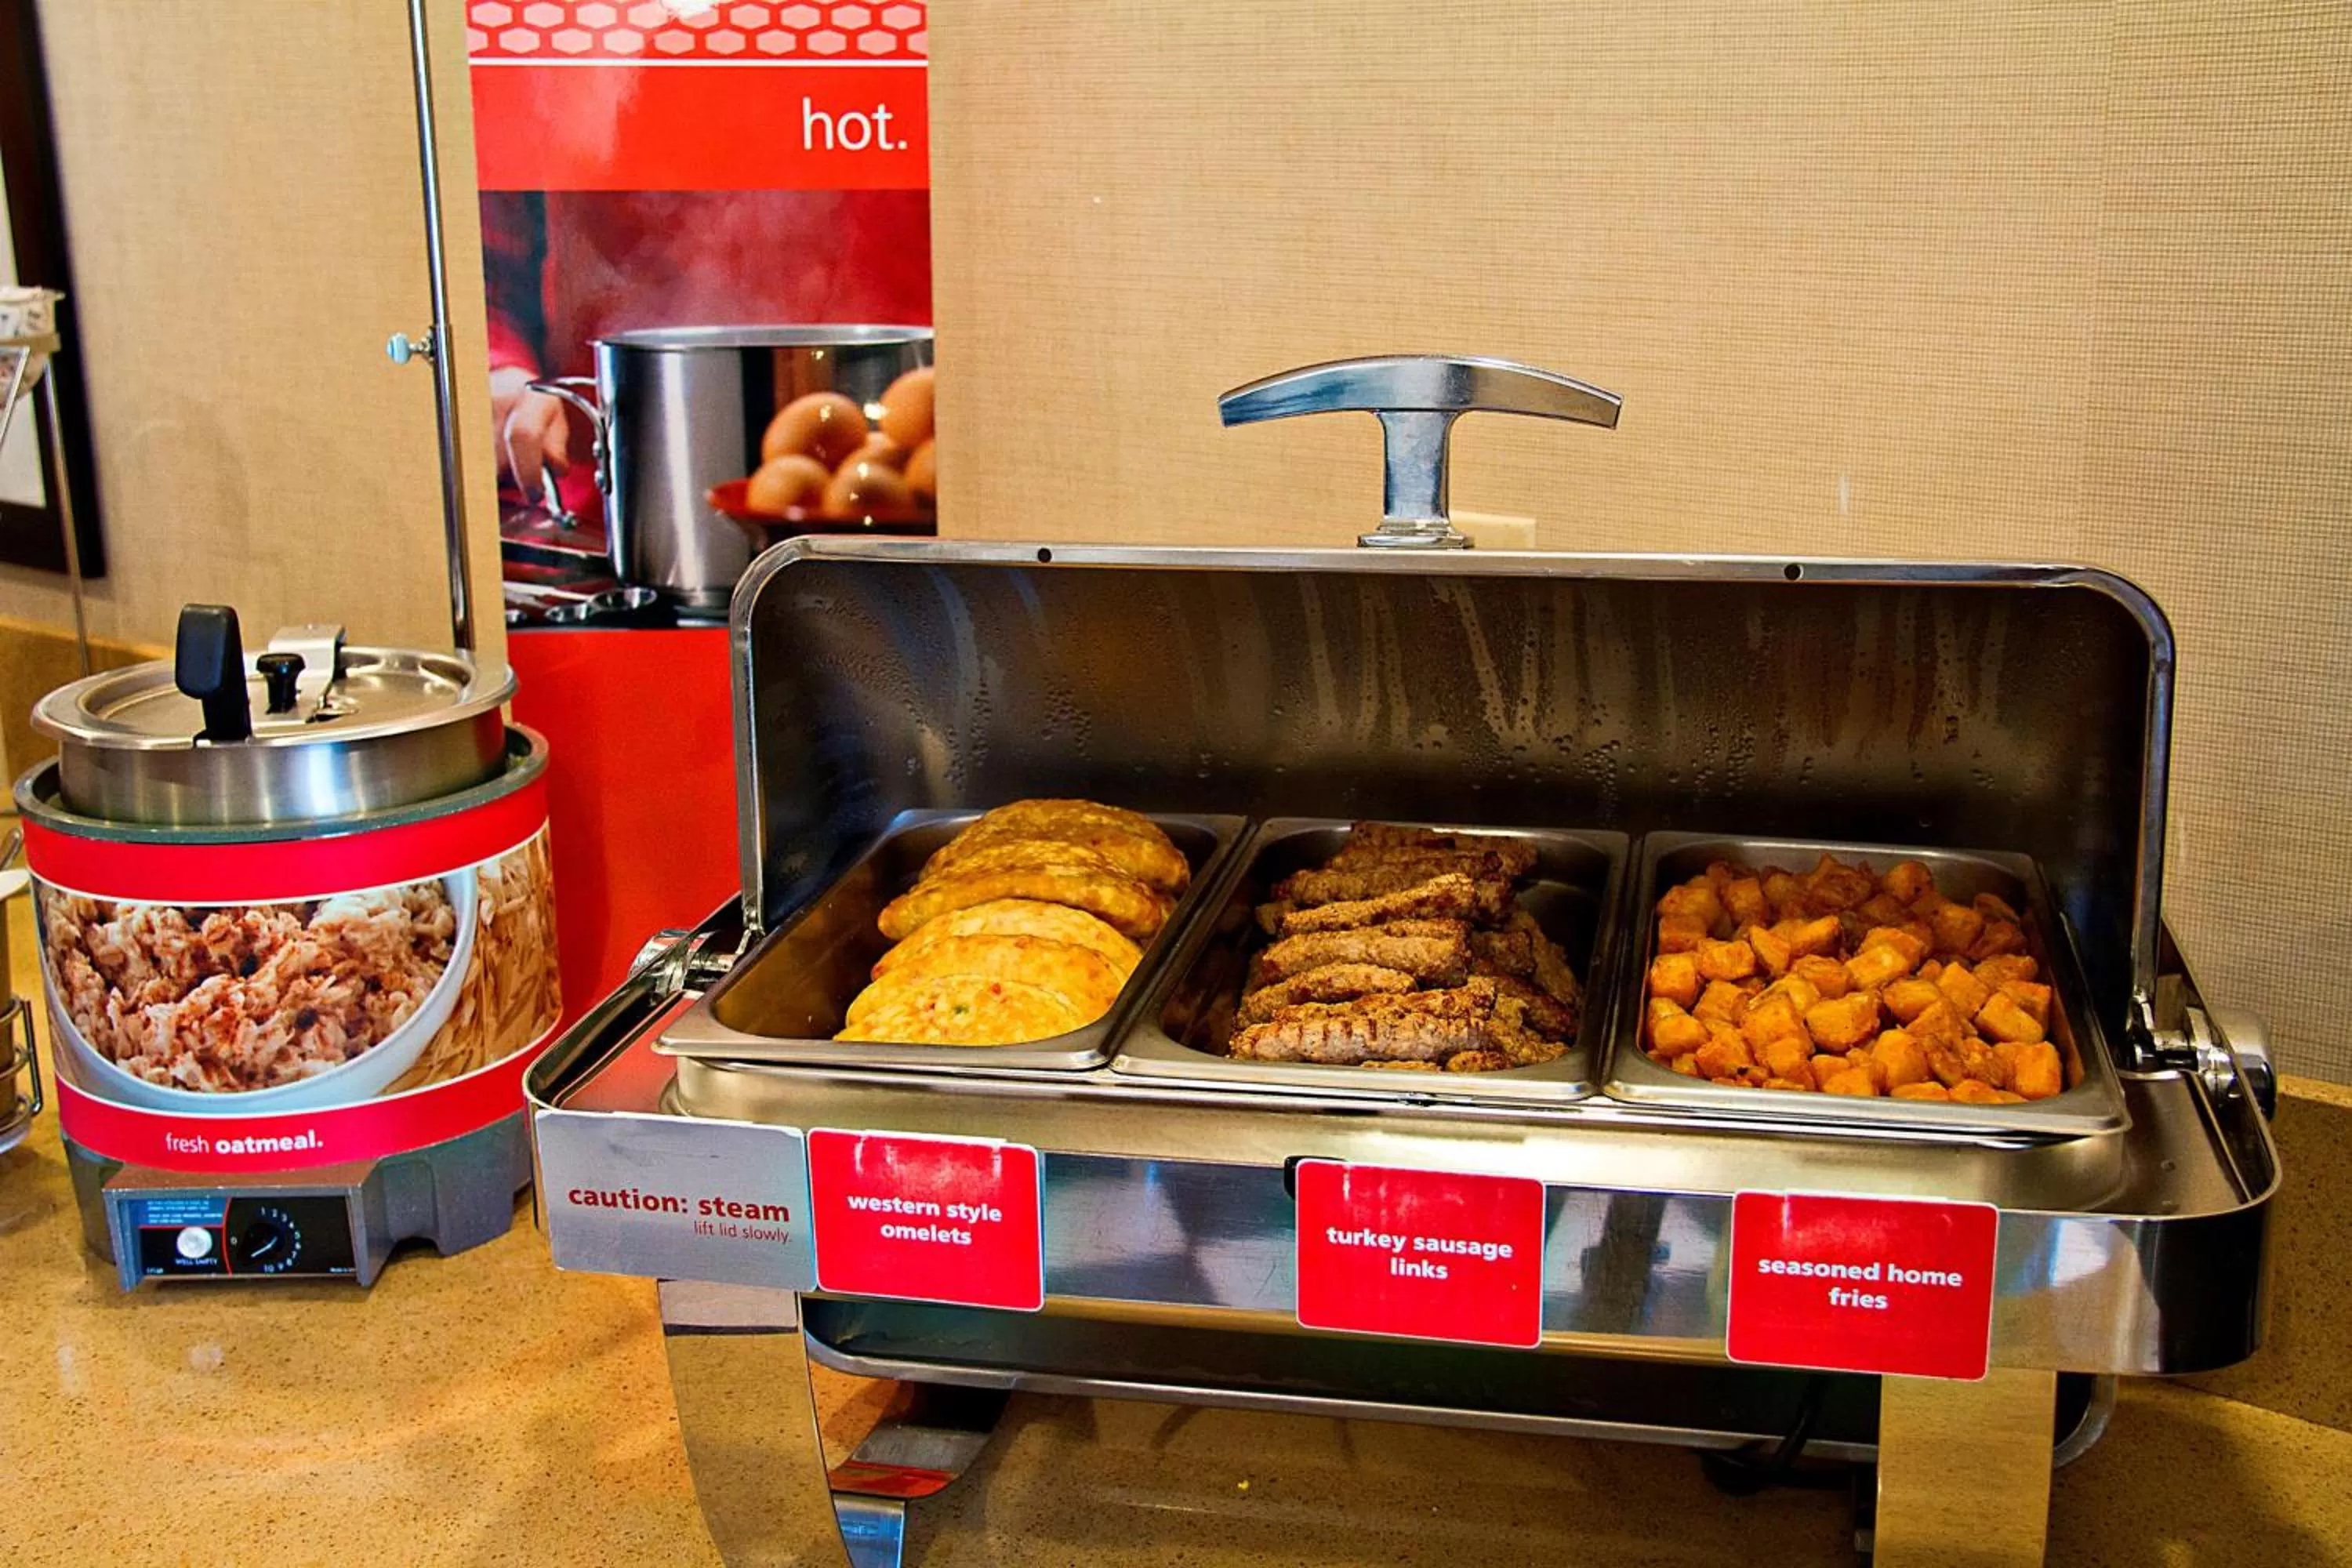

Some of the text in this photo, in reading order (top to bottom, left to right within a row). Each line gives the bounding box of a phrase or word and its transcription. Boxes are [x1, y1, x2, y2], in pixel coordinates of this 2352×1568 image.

[802, 96, 908, 151] hot.
[165, 1129, 324, 1154] fresh oatmeal.
[272, 1208, 278, 1218] 2
[568, 1187, 790, 1222] caution: steam
[848, 1195, 1003, 1224] western style
[694, 1220, 793, 1245] lift lid slowly.
[880, 1223, 972, 1245] omelets
[1326, 1226, 1514, 1261] turkey sausage
[263, 1264, 274, 1272] 10
[1389, 1257, 1449, 1280] links
[1758, 1258, 1963, 1287] seasoned home
[1828, 1286, 1889, 1310] fries
